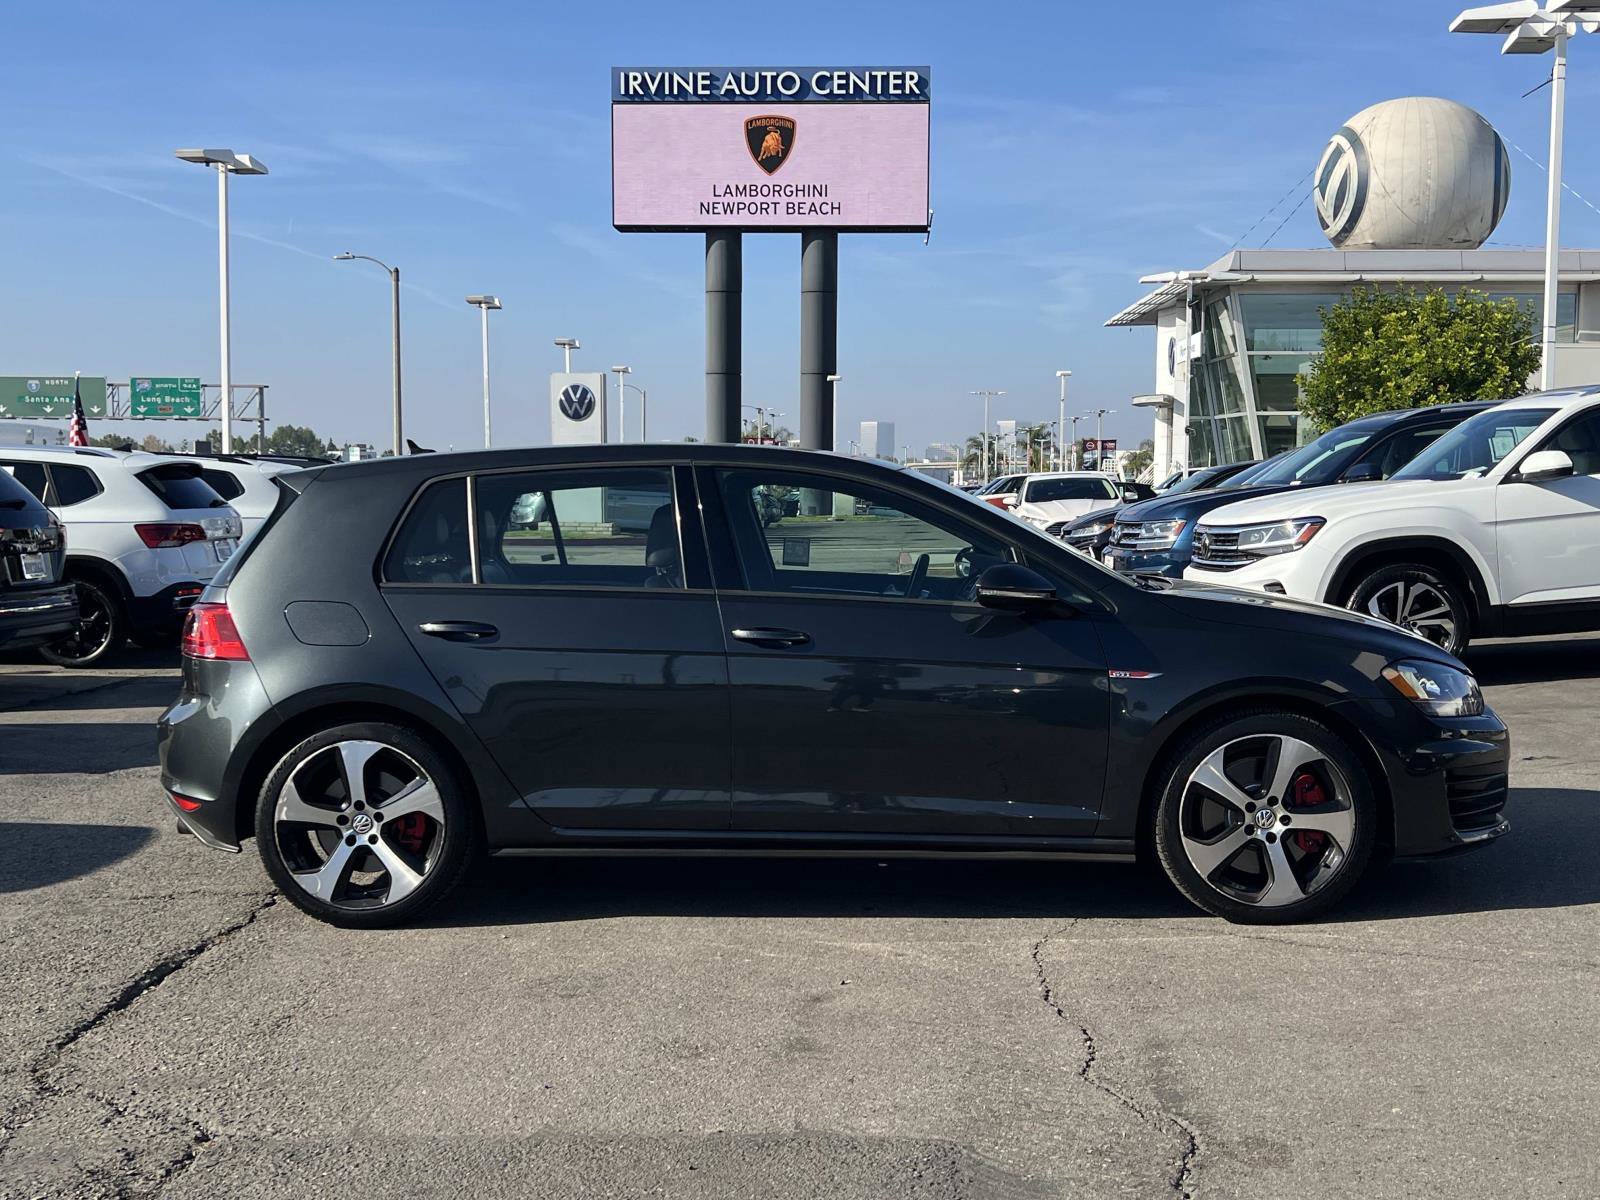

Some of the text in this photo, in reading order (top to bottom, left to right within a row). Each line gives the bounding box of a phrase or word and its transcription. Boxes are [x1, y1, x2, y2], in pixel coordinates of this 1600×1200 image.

[620, 71, 921, 95] IRVINE AUTO CENTER
[747, 118, 794, 129] LAMBORGHINI
[713, 184, 828, 198] LAMBORGHINI
[699, 201, 841, 215] NEWPORT BEACH
[24, 395, 70, 403] Santa Ana
[141, 395, 190, 404] Long Beach
